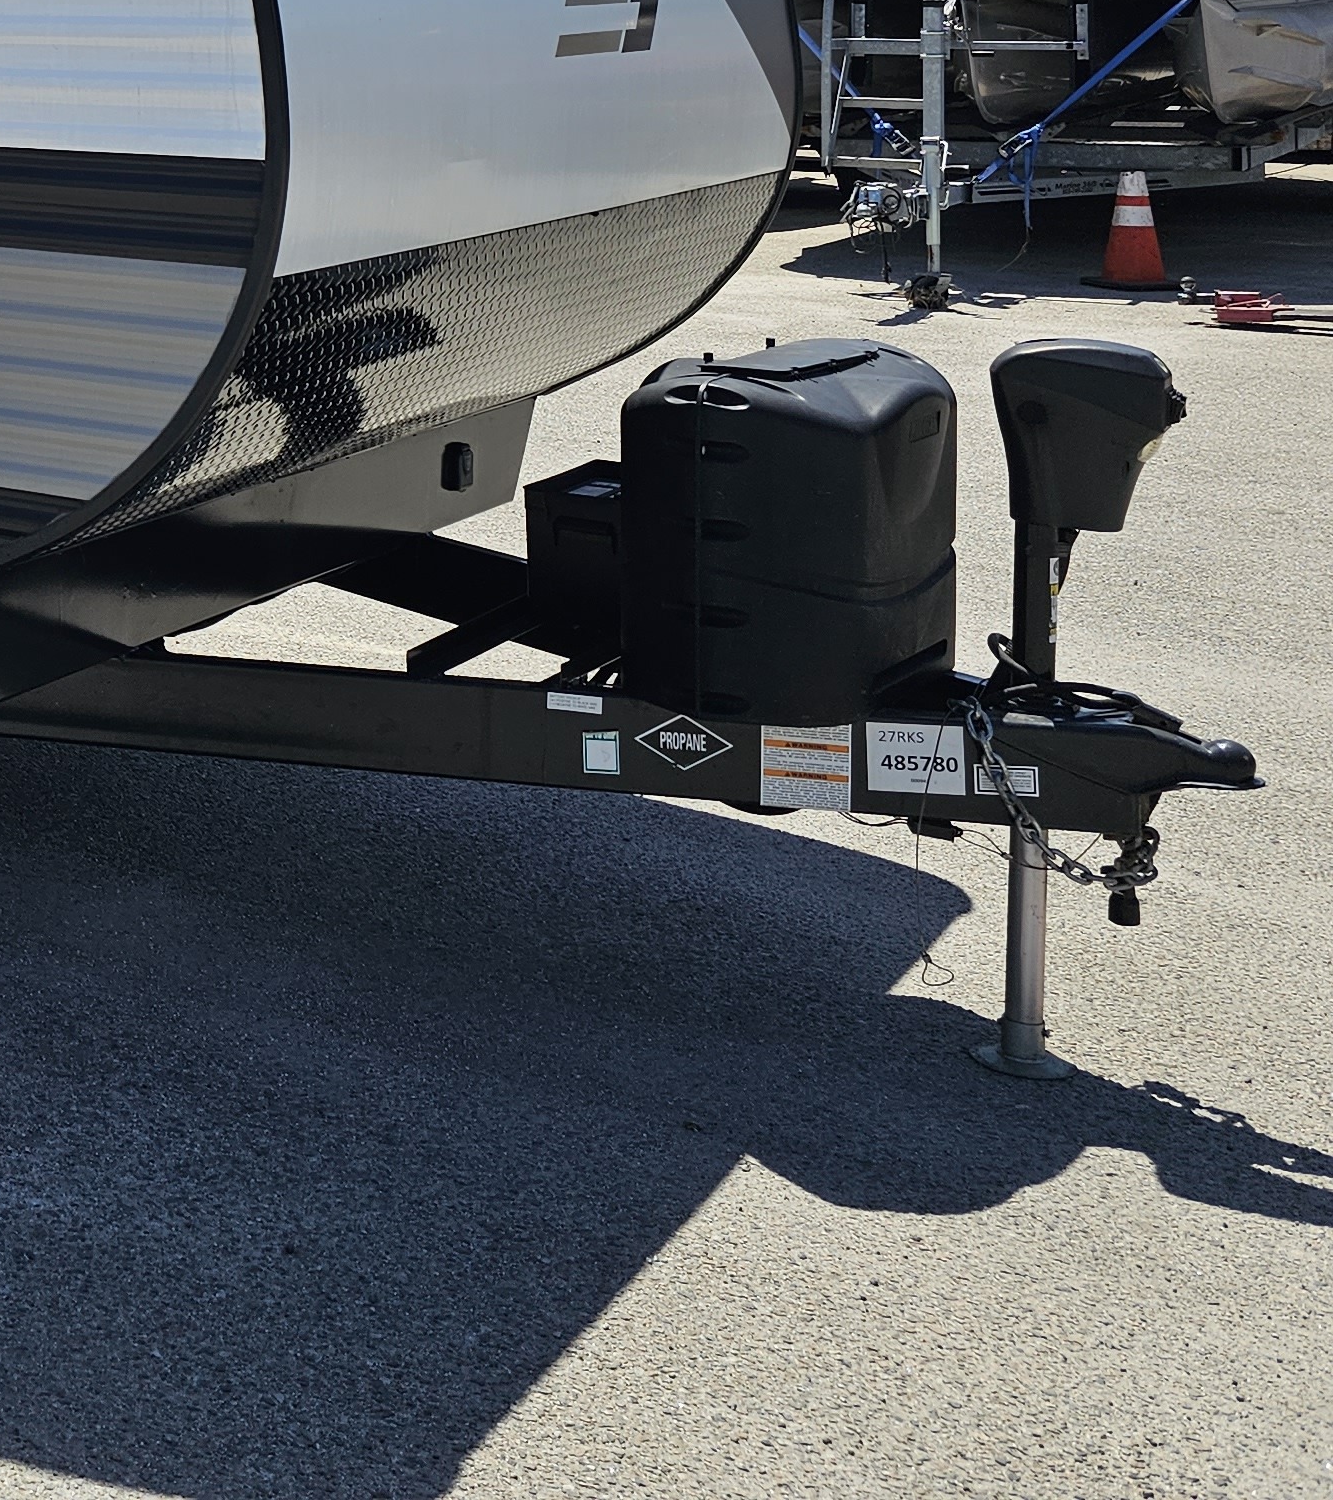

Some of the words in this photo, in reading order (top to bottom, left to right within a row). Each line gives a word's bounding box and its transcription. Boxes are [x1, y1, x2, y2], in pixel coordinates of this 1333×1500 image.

[659, 731, 707, 752] PROPANE
[878, 730, 925, 744] 27RKS
[793, 741, 828, 751] WARNING
[881, 755, 958, 773] 485780
[793, 771, 828, 780] WARNING
